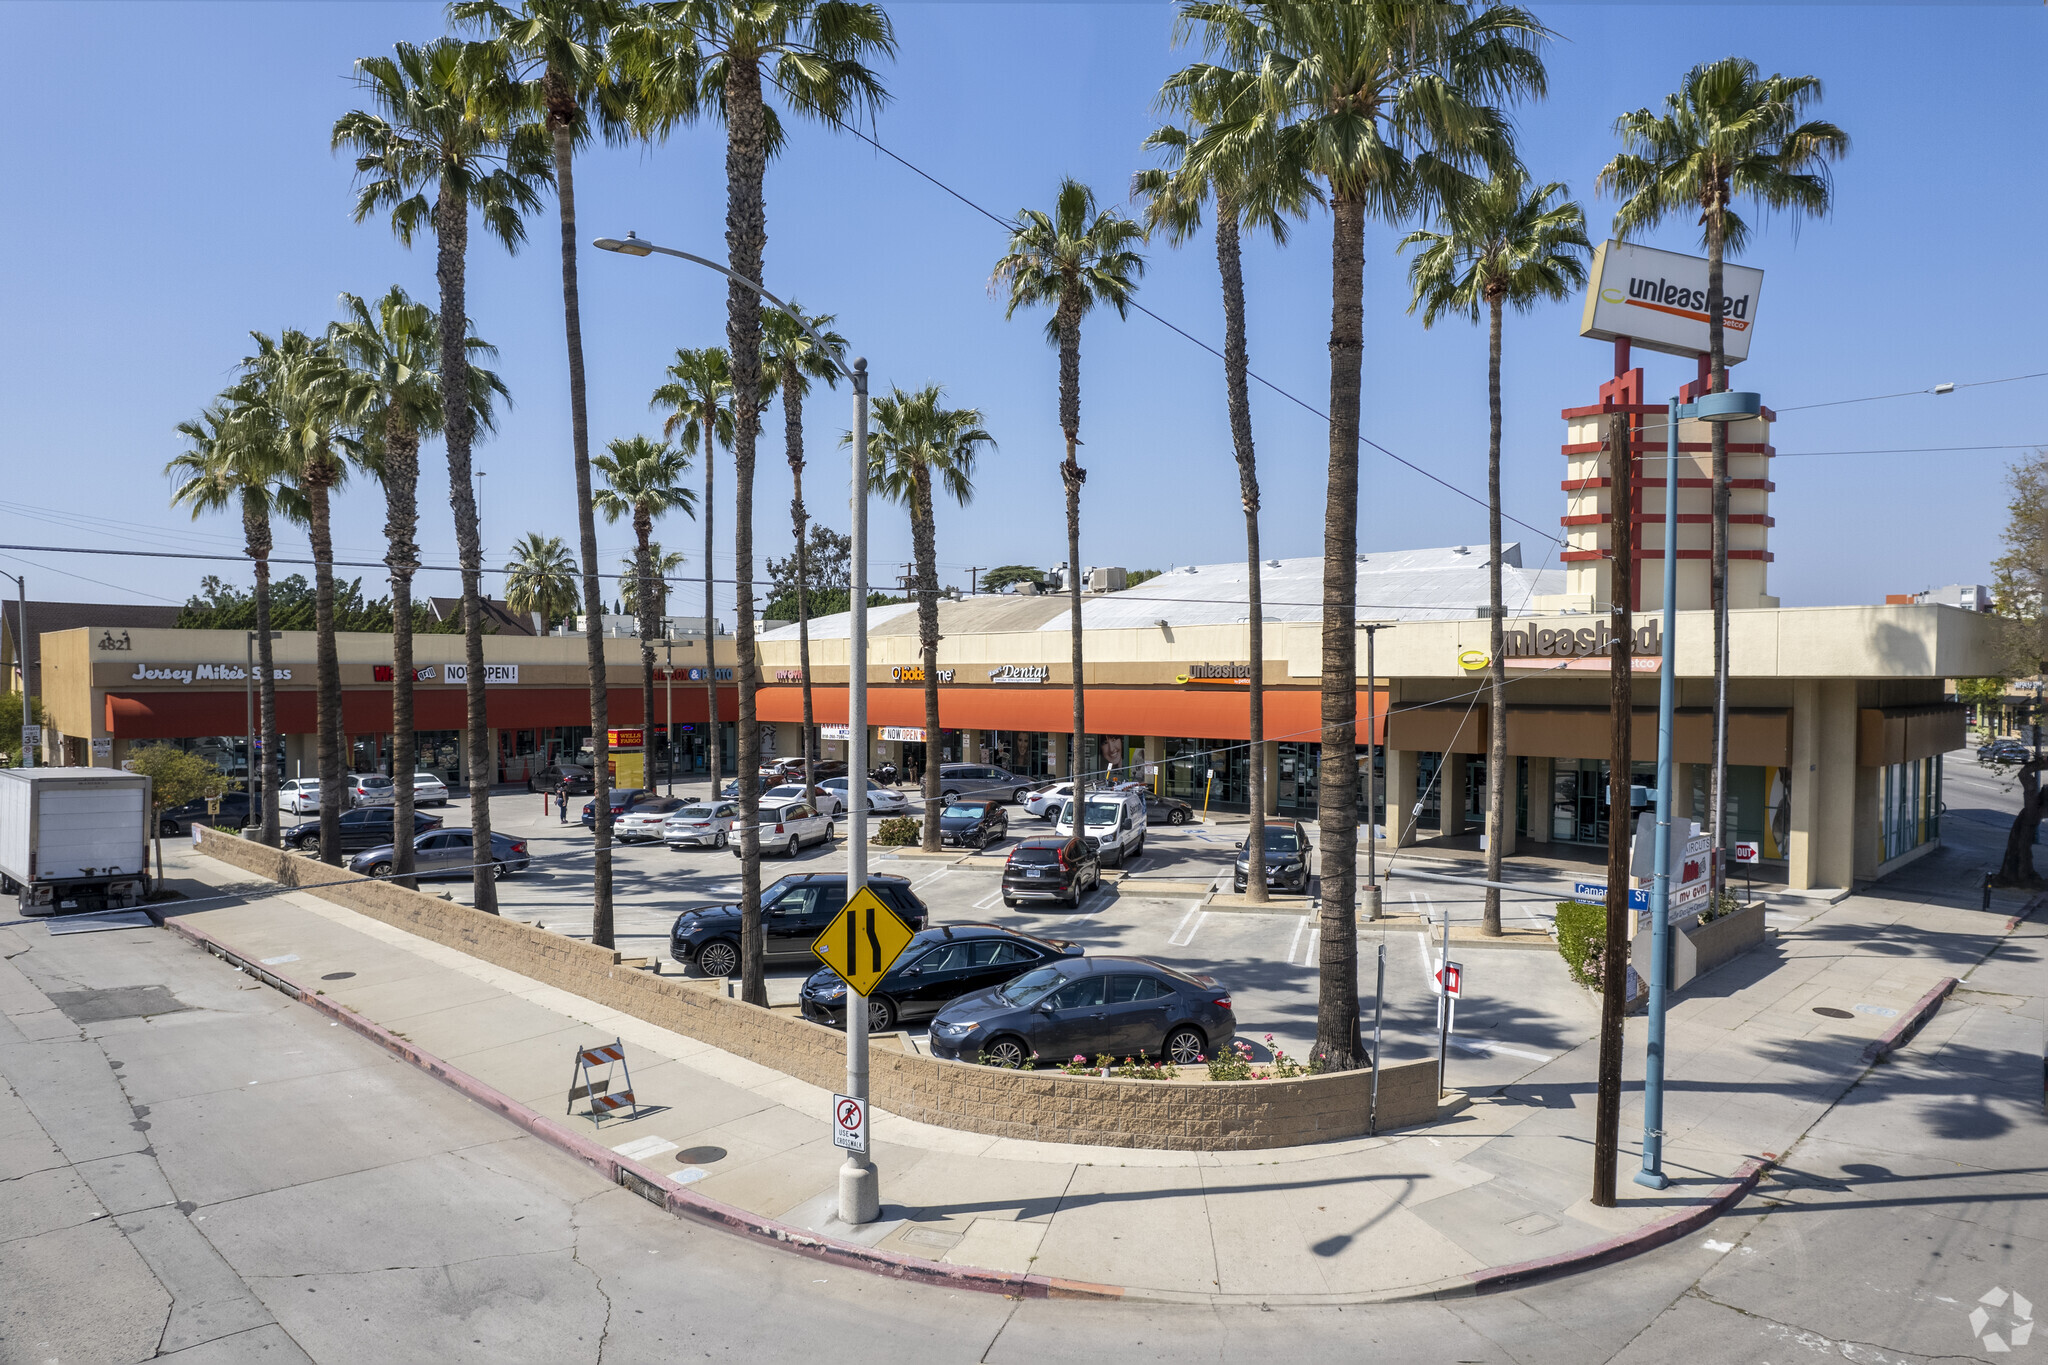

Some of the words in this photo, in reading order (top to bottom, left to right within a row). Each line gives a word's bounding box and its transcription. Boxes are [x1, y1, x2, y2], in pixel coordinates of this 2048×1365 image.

[98, 638, 132, 651] 4821
[132, 664, 192, 684] Jersey
[196, 664, 248, 681] Mike's
[701, 668, 733, 681] POTO
[901, 666, 926, 682] boba
[1003, 664, 1048, 678] Dental
[24, 735, 39, 744] 35
[887, 727, 901, 739] NOW
[902, 729, 919, 740] OPEN
[1737, 847, 1751, 857] OUT
[1635, 891, 1646, 902] St
[1680, 892, 1690, 903] MY
[1692, 884, 1707, 898] GYM
[1446, 971, 1456, 988] IN
[838, 1129, 849, 1138] USE
[836, 1137, 862, 1149] CROSSWALK
